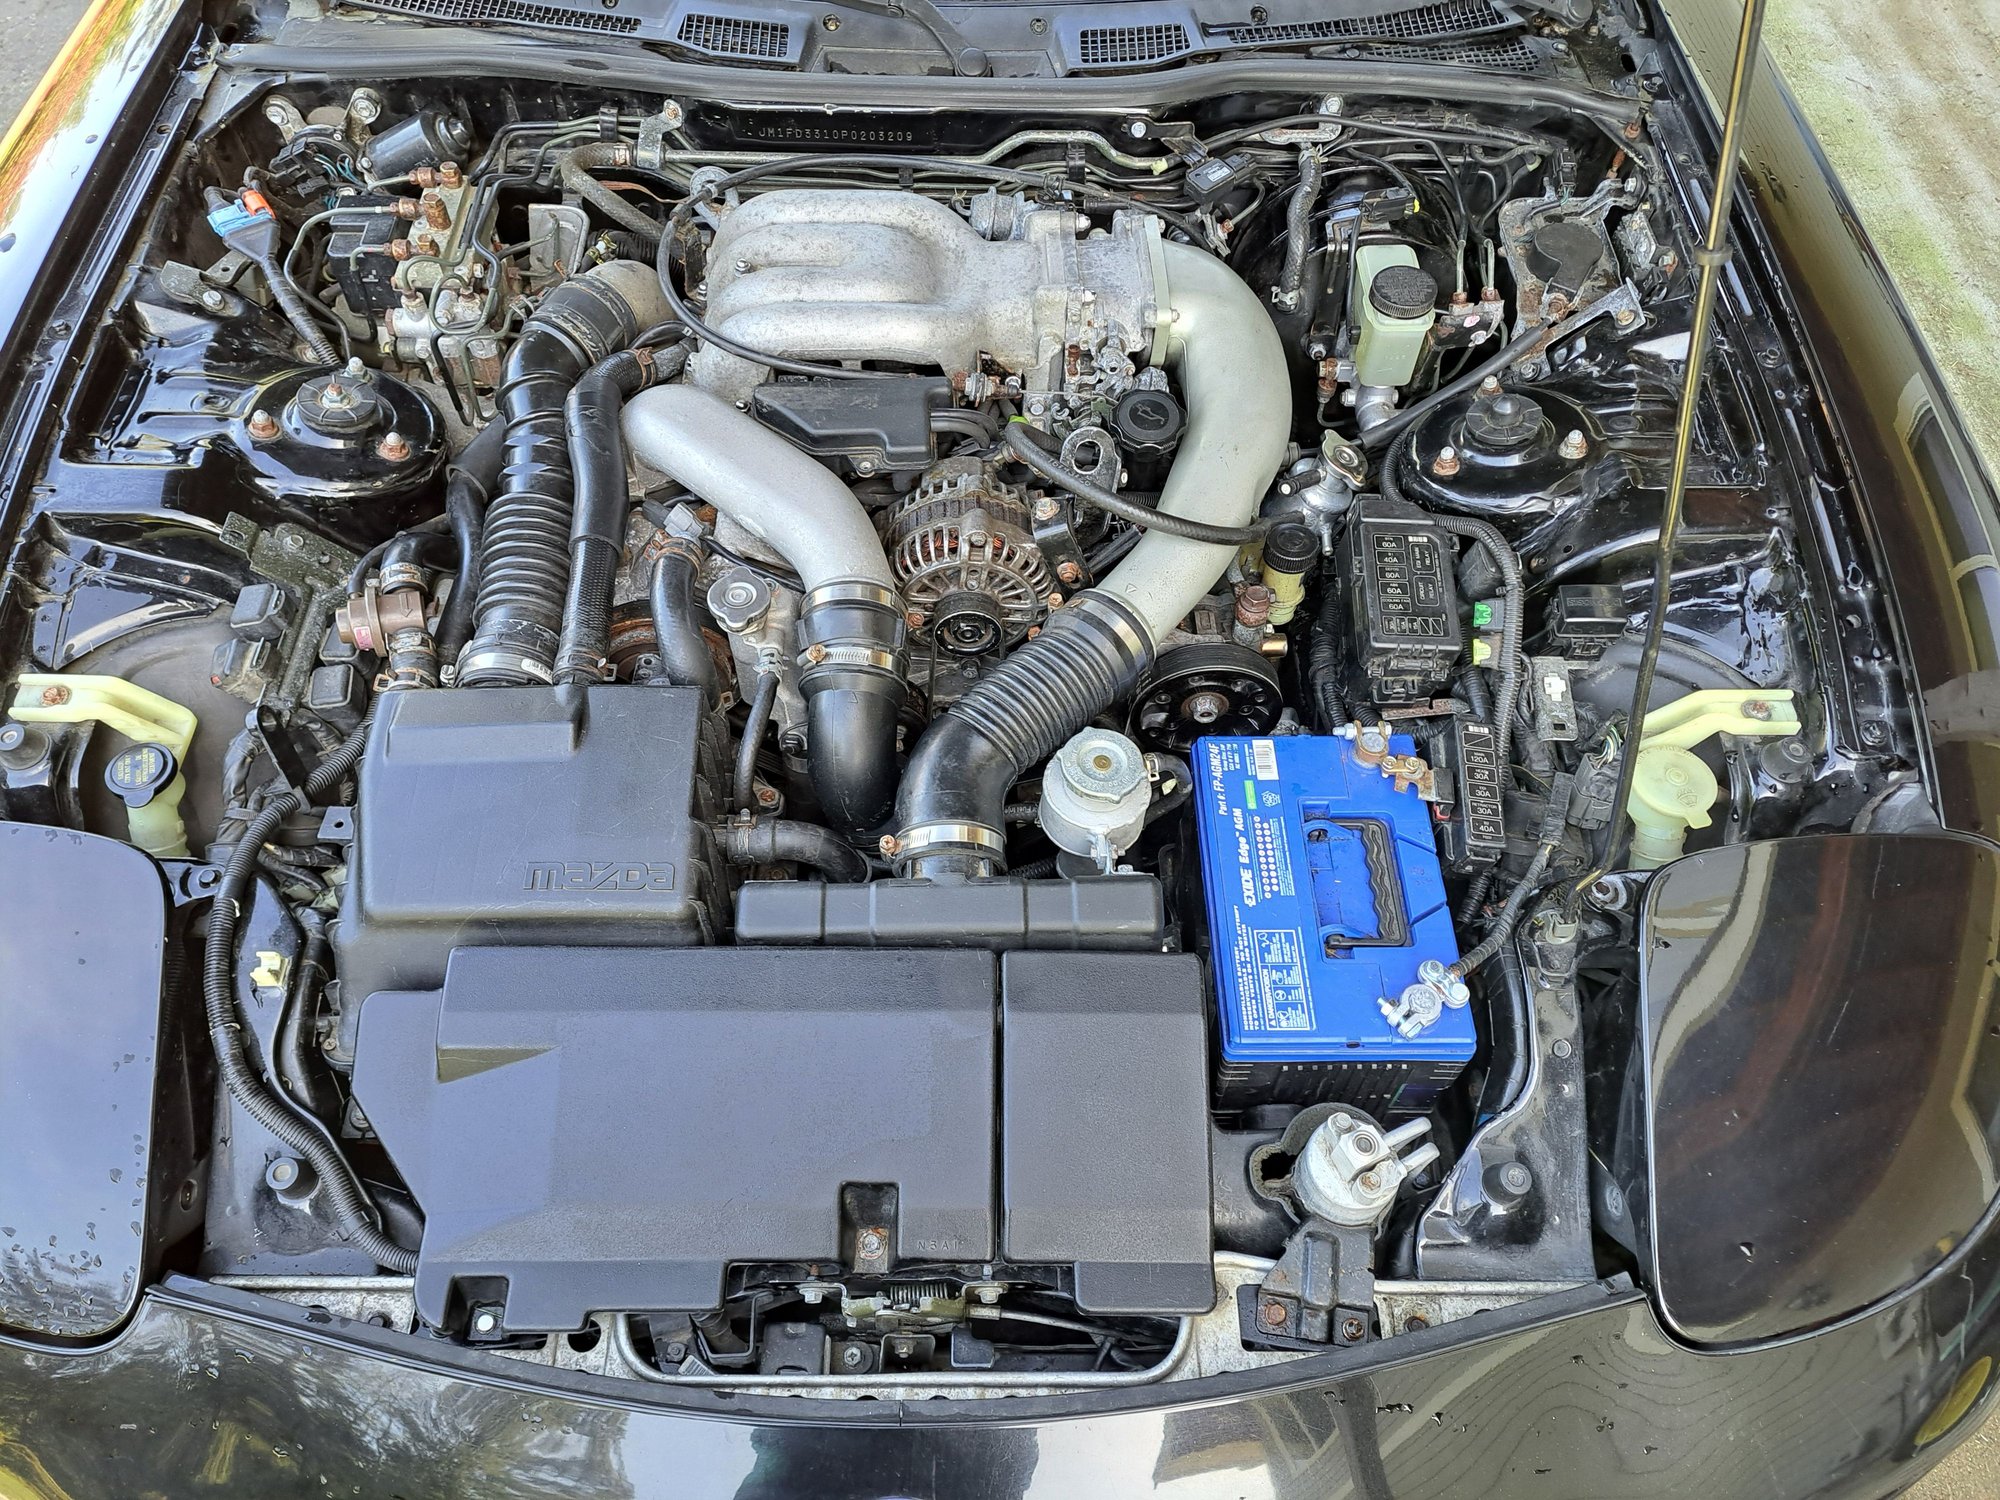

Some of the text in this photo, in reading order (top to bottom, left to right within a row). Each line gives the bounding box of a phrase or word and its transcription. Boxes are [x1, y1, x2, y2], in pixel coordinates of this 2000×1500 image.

[759, 127, 913, 141] JM1FD3310P0203209
[1385, 571, 1400, 579] 60A
[1470, 755, 1489, 764] 120A
[1208, 743, 1225, 792] FP-AGM24F
[1474, 772, 1489, 781] 30A
[1475, 789, 1491, 798] 30A
[1218, 801, 1228, 816] Part
[1477, 807, 1493, 816] 30A
[1232, 807, 1245, 831] AGM
[1479, 824, 1495, 833] 40A
[1240, 867, 1256, 907] EXIDE
[1248, 974, 1256, 998] VENTS
[1254, 1020, 1260, 1031] TO
